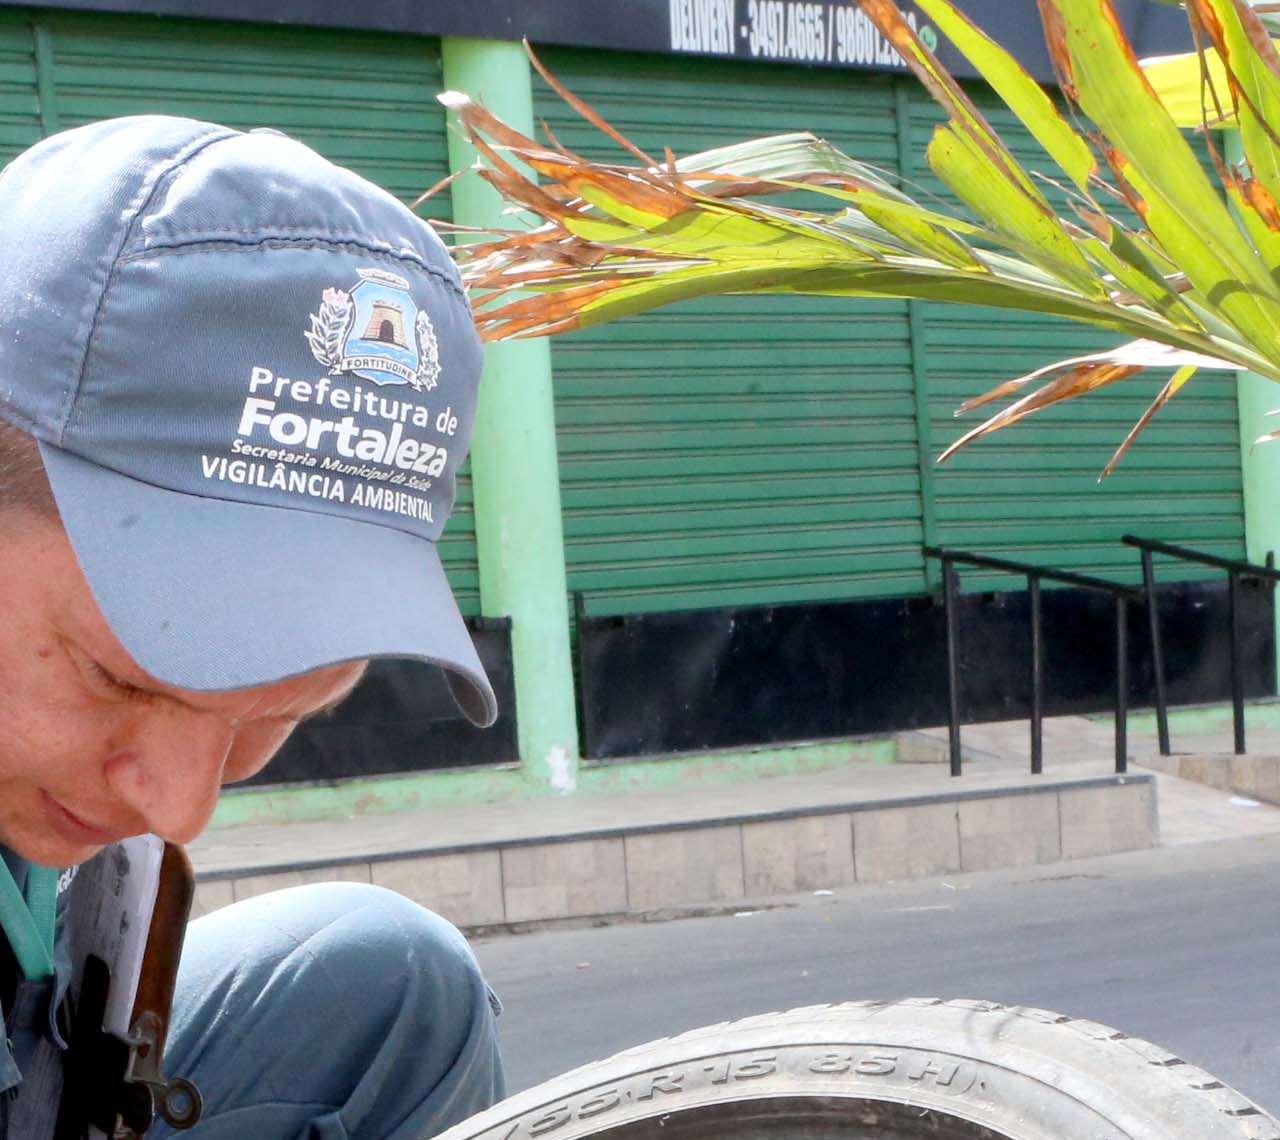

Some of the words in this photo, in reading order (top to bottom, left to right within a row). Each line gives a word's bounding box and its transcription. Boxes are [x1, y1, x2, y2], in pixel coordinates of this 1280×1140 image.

[669, 0, 735, 54] DELIVERY
[748, 0, 825, 62] 3497.4665
[248, 366, 429, 429] Prefeitura
[435, 405, 458, 437] de
[346, 358, 414, 381] FORTITUDINE
[230, 438, 317, 468] Secretaria
[319, 456, 395, 485] Municipal
[390, 468, 407, 485] de
[237, 396, 448, 479] Fortaleza
[200, 455, 346, 502] VIGILÂNCIA
[350, 483, 435, 524] AMBIENTAL
